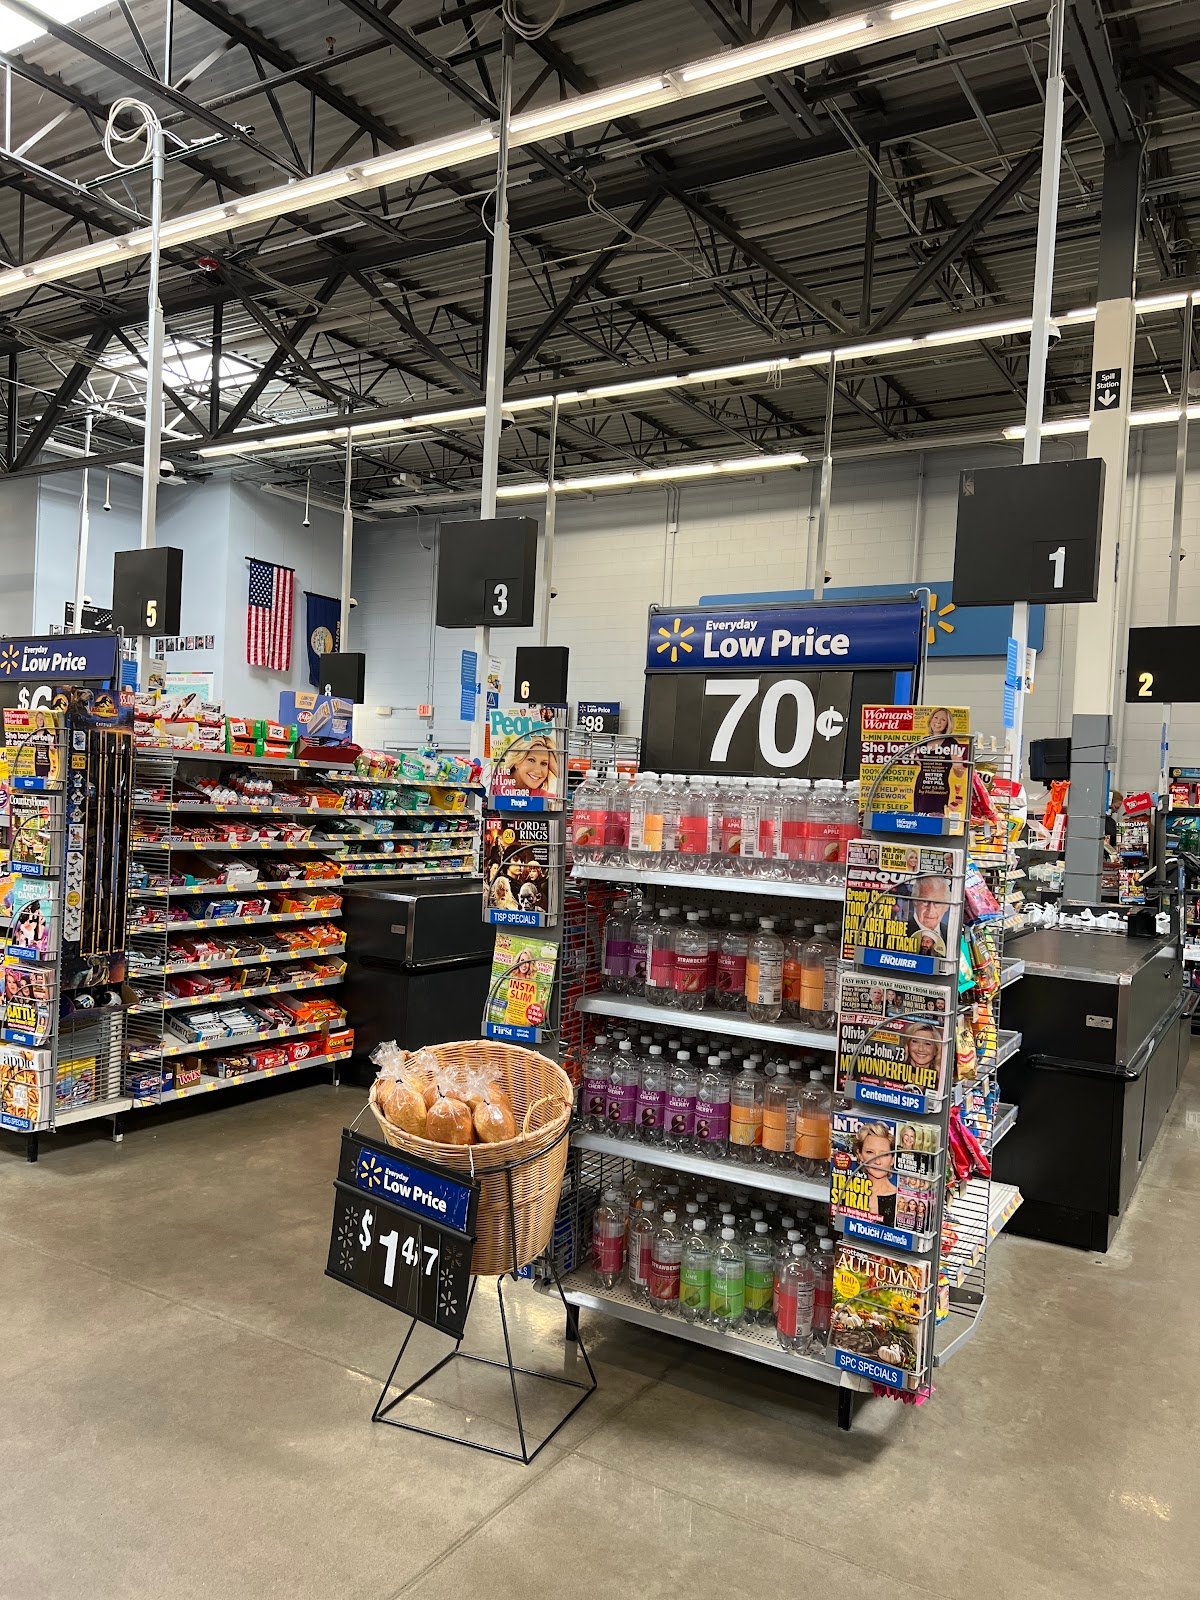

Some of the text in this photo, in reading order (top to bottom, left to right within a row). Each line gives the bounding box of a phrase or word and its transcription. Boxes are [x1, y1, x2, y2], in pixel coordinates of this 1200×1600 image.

[1101, 373, 1115, 382] Spill
[1096, 381, 1119, 391] Station
[1048, 546, 1066, 588] 1
[493, 583, 508, 616] 3
[146, 600, 157, 627] 5
[706, 619, 758, 632] Everyday
[24, 645, 48, 655] Everyday
[703, 627, 850, 658] Low Price
[21, 651, 87, 672] Low Price
[520, 681, 530, 699] 6
[1138, 672, 1154, 697] 2
[864, 707, 913, 720] Woman's
[581, 715, 604, 732] $98
[704, 678, 846, 768] 70¢
[864, 720, 899, 730] World
[861, 742, 885, 753] She
[934, 744, 965, 758] belly
[861, 753, 875, 763] at
[497, 767, 511, 776] Life
[499, 779, 516, 787] Love
[500, 787, 530, 797] Courage
[510, 799, 528, 808] People
[486, 820, 502, 830] LIFE
[514, 820, 540, 831] LORD
[519, 830, 549, 840] RINGS
[846, 888, 870, 904] Greedy
[846, 901, 865, 916] TOOK
[494, 912, 536, 924] TISP SPECIALS
[845, 915, 860, 930] BIN
[886, 919, 909, 937] BRIBE
[868, 932, 885, 949] 9/11
[886, 935, 918, 953] ATTACK!
[879, 955, 918, 970] ENQUIRER
[509, 979, 536, 994] INSTA
[509, 990, 532, 1003] SLIM
[493, 1026, 512, 1037] First
[841, 1025, 865, 1040] Olivia
[895, 1046, 910, 1062] 73
[857, 1056, 913, 1082] WONDERFUL
[913, 1066, 938, 1090] LIFE!
[669, 1101, 690, 1109] CHERRY
[861, 1087, 920, 1111] Centennial SIPS
[384, 1167, 409, 1184] Everyday
[383, 1177, 447, 1215] Low Price
[685, 1273, 698, 1282] LIME
[836, 1252, 920, 1292] AUTUMN
[840, 1355, 898, 1384] SPC SPECIALS
